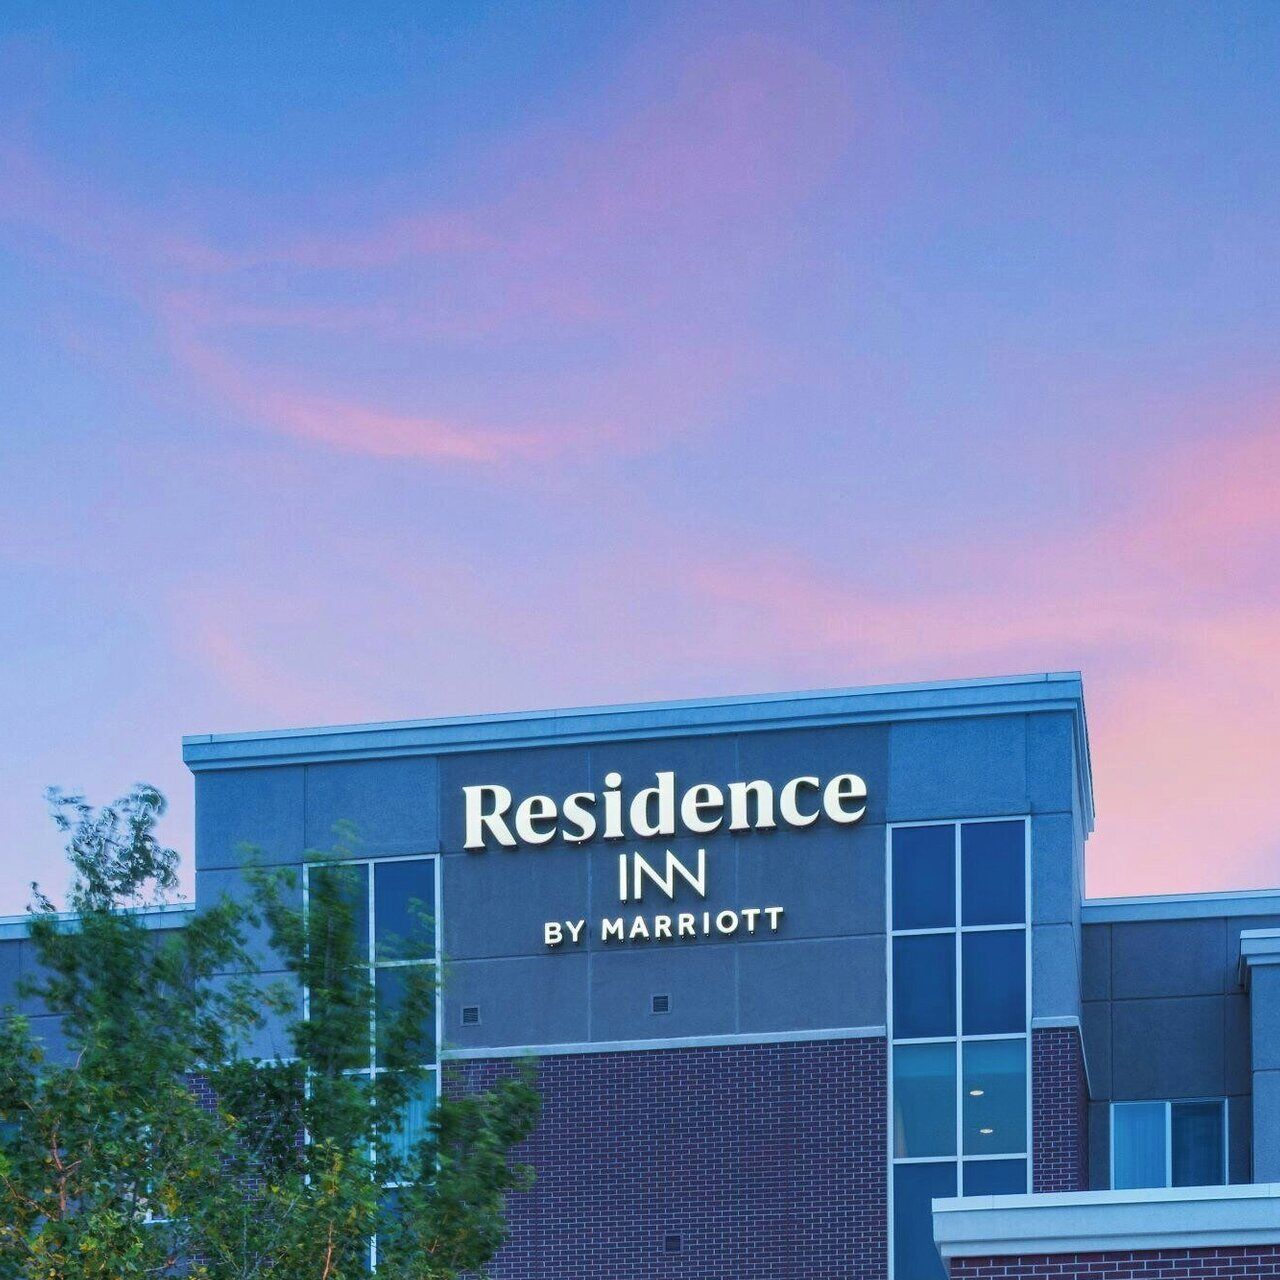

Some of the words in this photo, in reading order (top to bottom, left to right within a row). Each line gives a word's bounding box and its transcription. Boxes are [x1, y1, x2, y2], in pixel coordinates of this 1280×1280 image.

[462, 771, 867, 850] Residence
[619, 848, 706, 901] INN
[544, 919, 585, 945] BY
[601, 906, 784, 941] MARRIOTT
